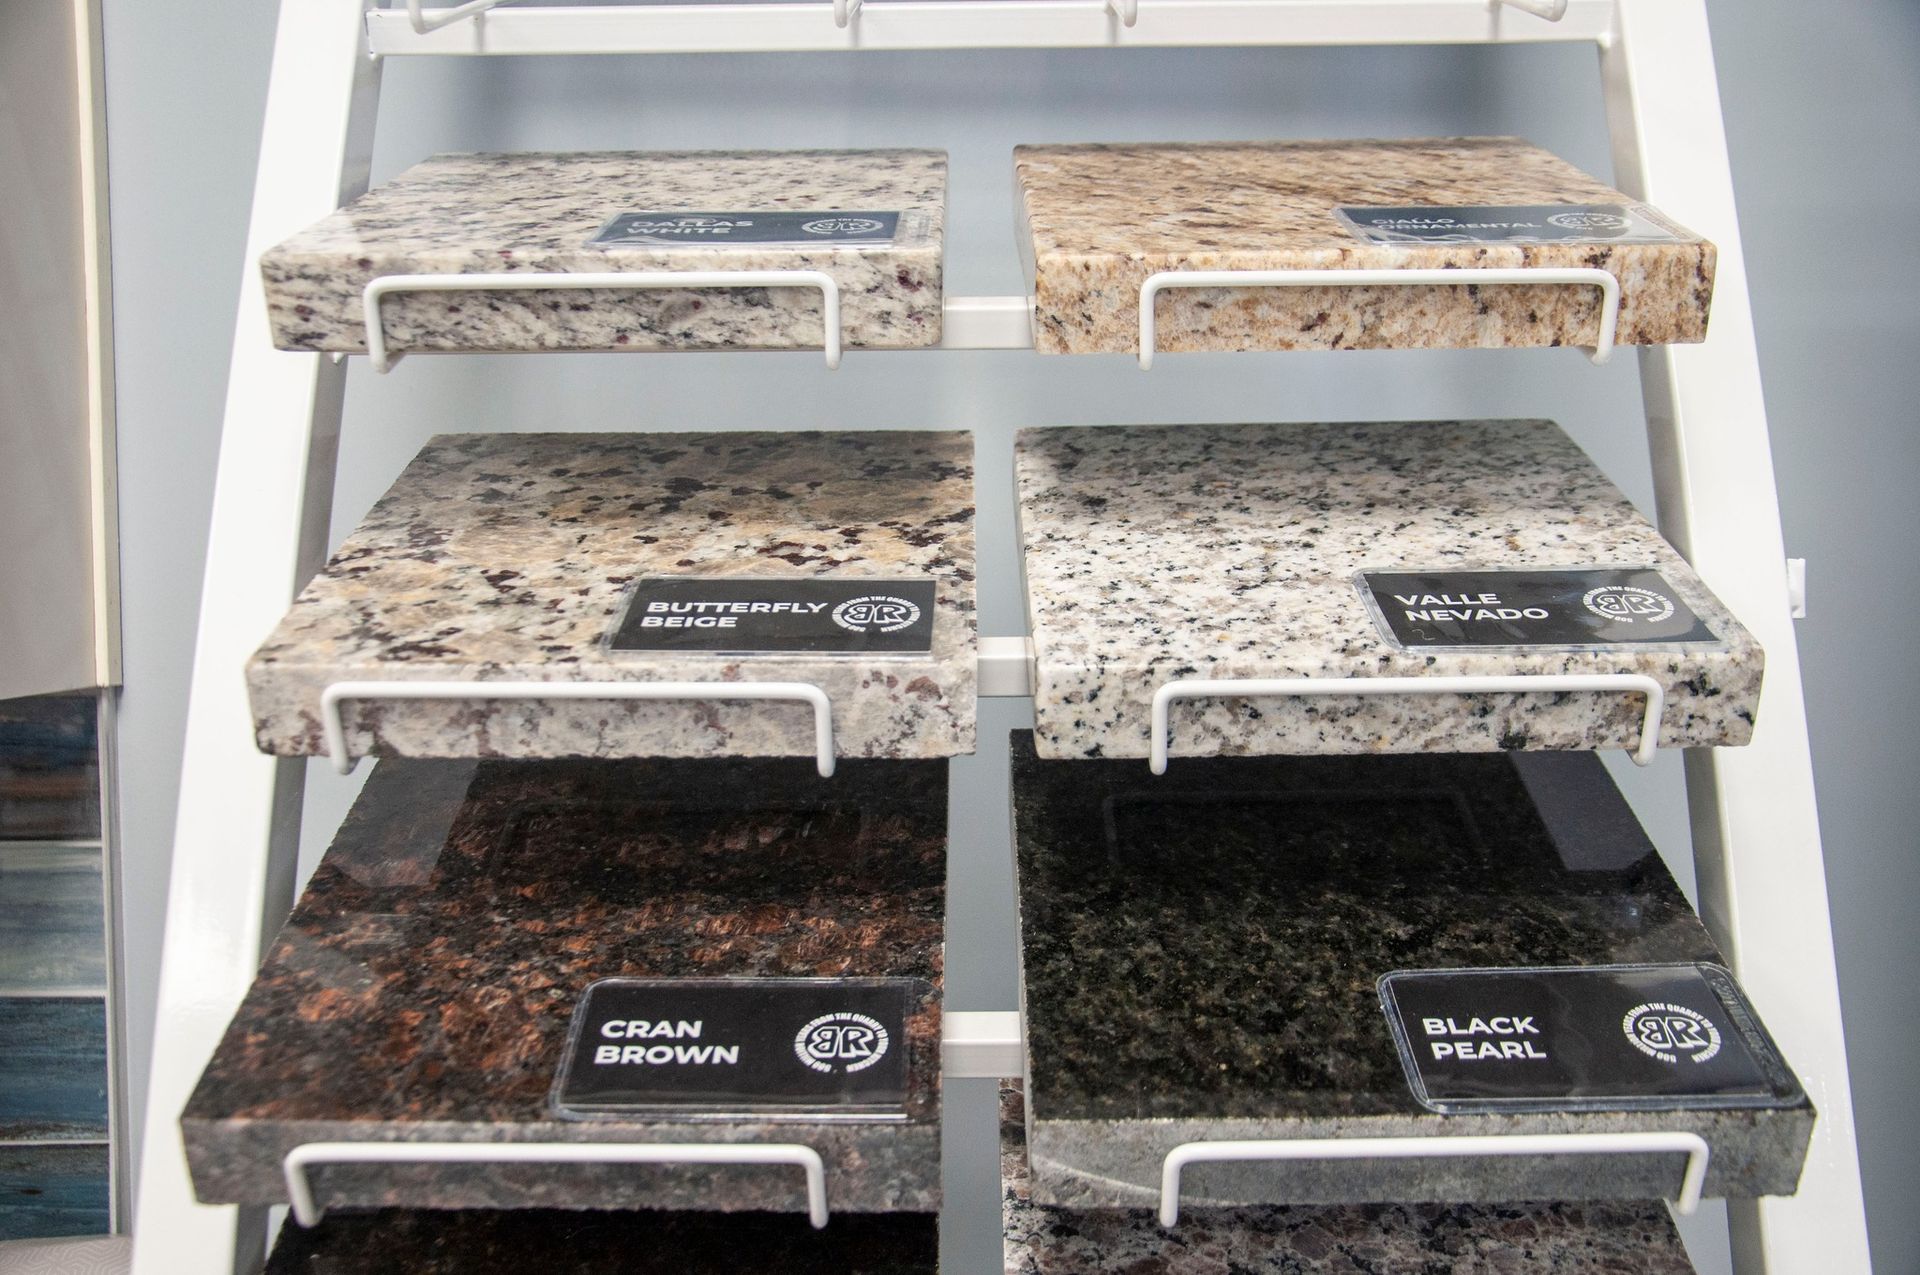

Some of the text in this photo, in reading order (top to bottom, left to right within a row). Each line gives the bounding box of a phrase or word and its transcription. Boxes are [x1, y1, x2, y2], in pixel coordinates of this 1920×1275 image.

[647, 602, 828, 613] BUTTERFLY
[1394, 593, 1501, 606] VALLE
[640, 617, 738, 628] BEIGE
[1405, 608, 1549, 622] NEVADO
[600, 1020, 703, 1039] CRAN
[1422, 1016, 1540, 1036] BLACK
[594, 1045, 740, 1065] BROWN
[1430, 1041, 1547, 1061] PEARL
